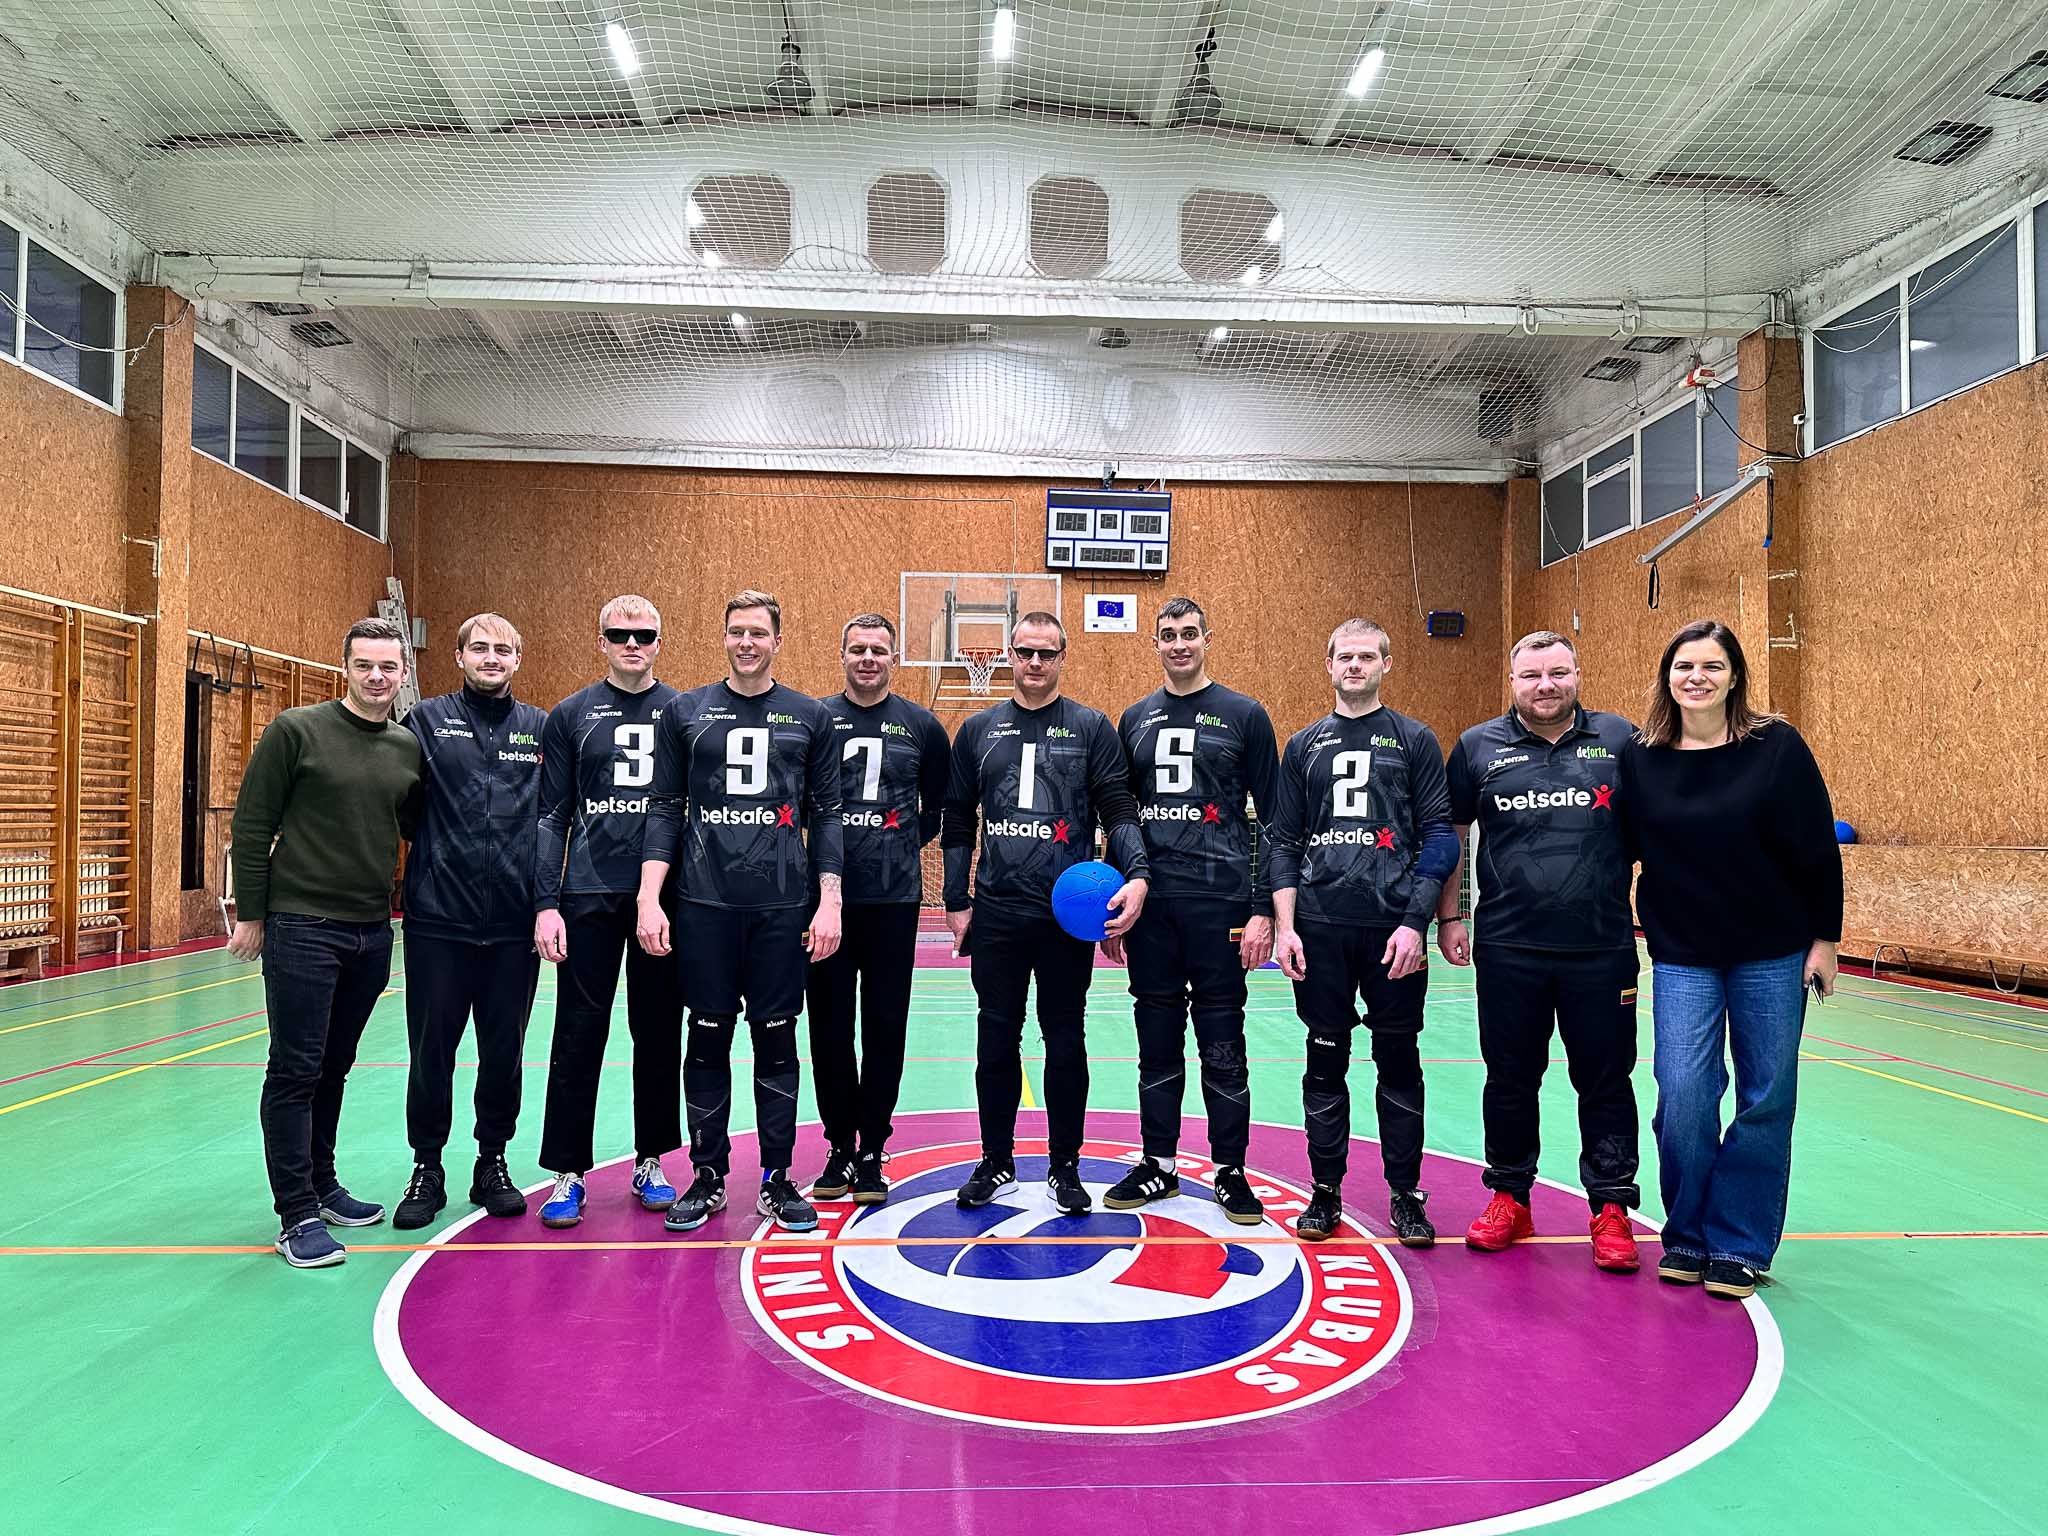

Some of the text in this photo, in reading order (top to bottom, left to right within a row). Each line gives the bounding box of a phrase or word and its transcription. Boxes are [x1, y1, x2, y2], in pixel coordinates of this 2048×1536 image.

[614, 724, 655, 787] 3
[726, 728, 770, 795] 9
[843, 737, 883, 801] 7
[1018, 743, 1036, 809] 1
[1155, 728, 1195, 794] 5
[1332, 751, 1371, 818] 2
[586, 796, 649, 815] betsaf
[700, 806, 776, 826] betsafe
[842, 808, 883, 828] safe
[986, 819, 1052, 840] betsafe
[1494, 786, 1591, 812] betsafe
[1234, 1254, 1383, 1394] KLUBAS
